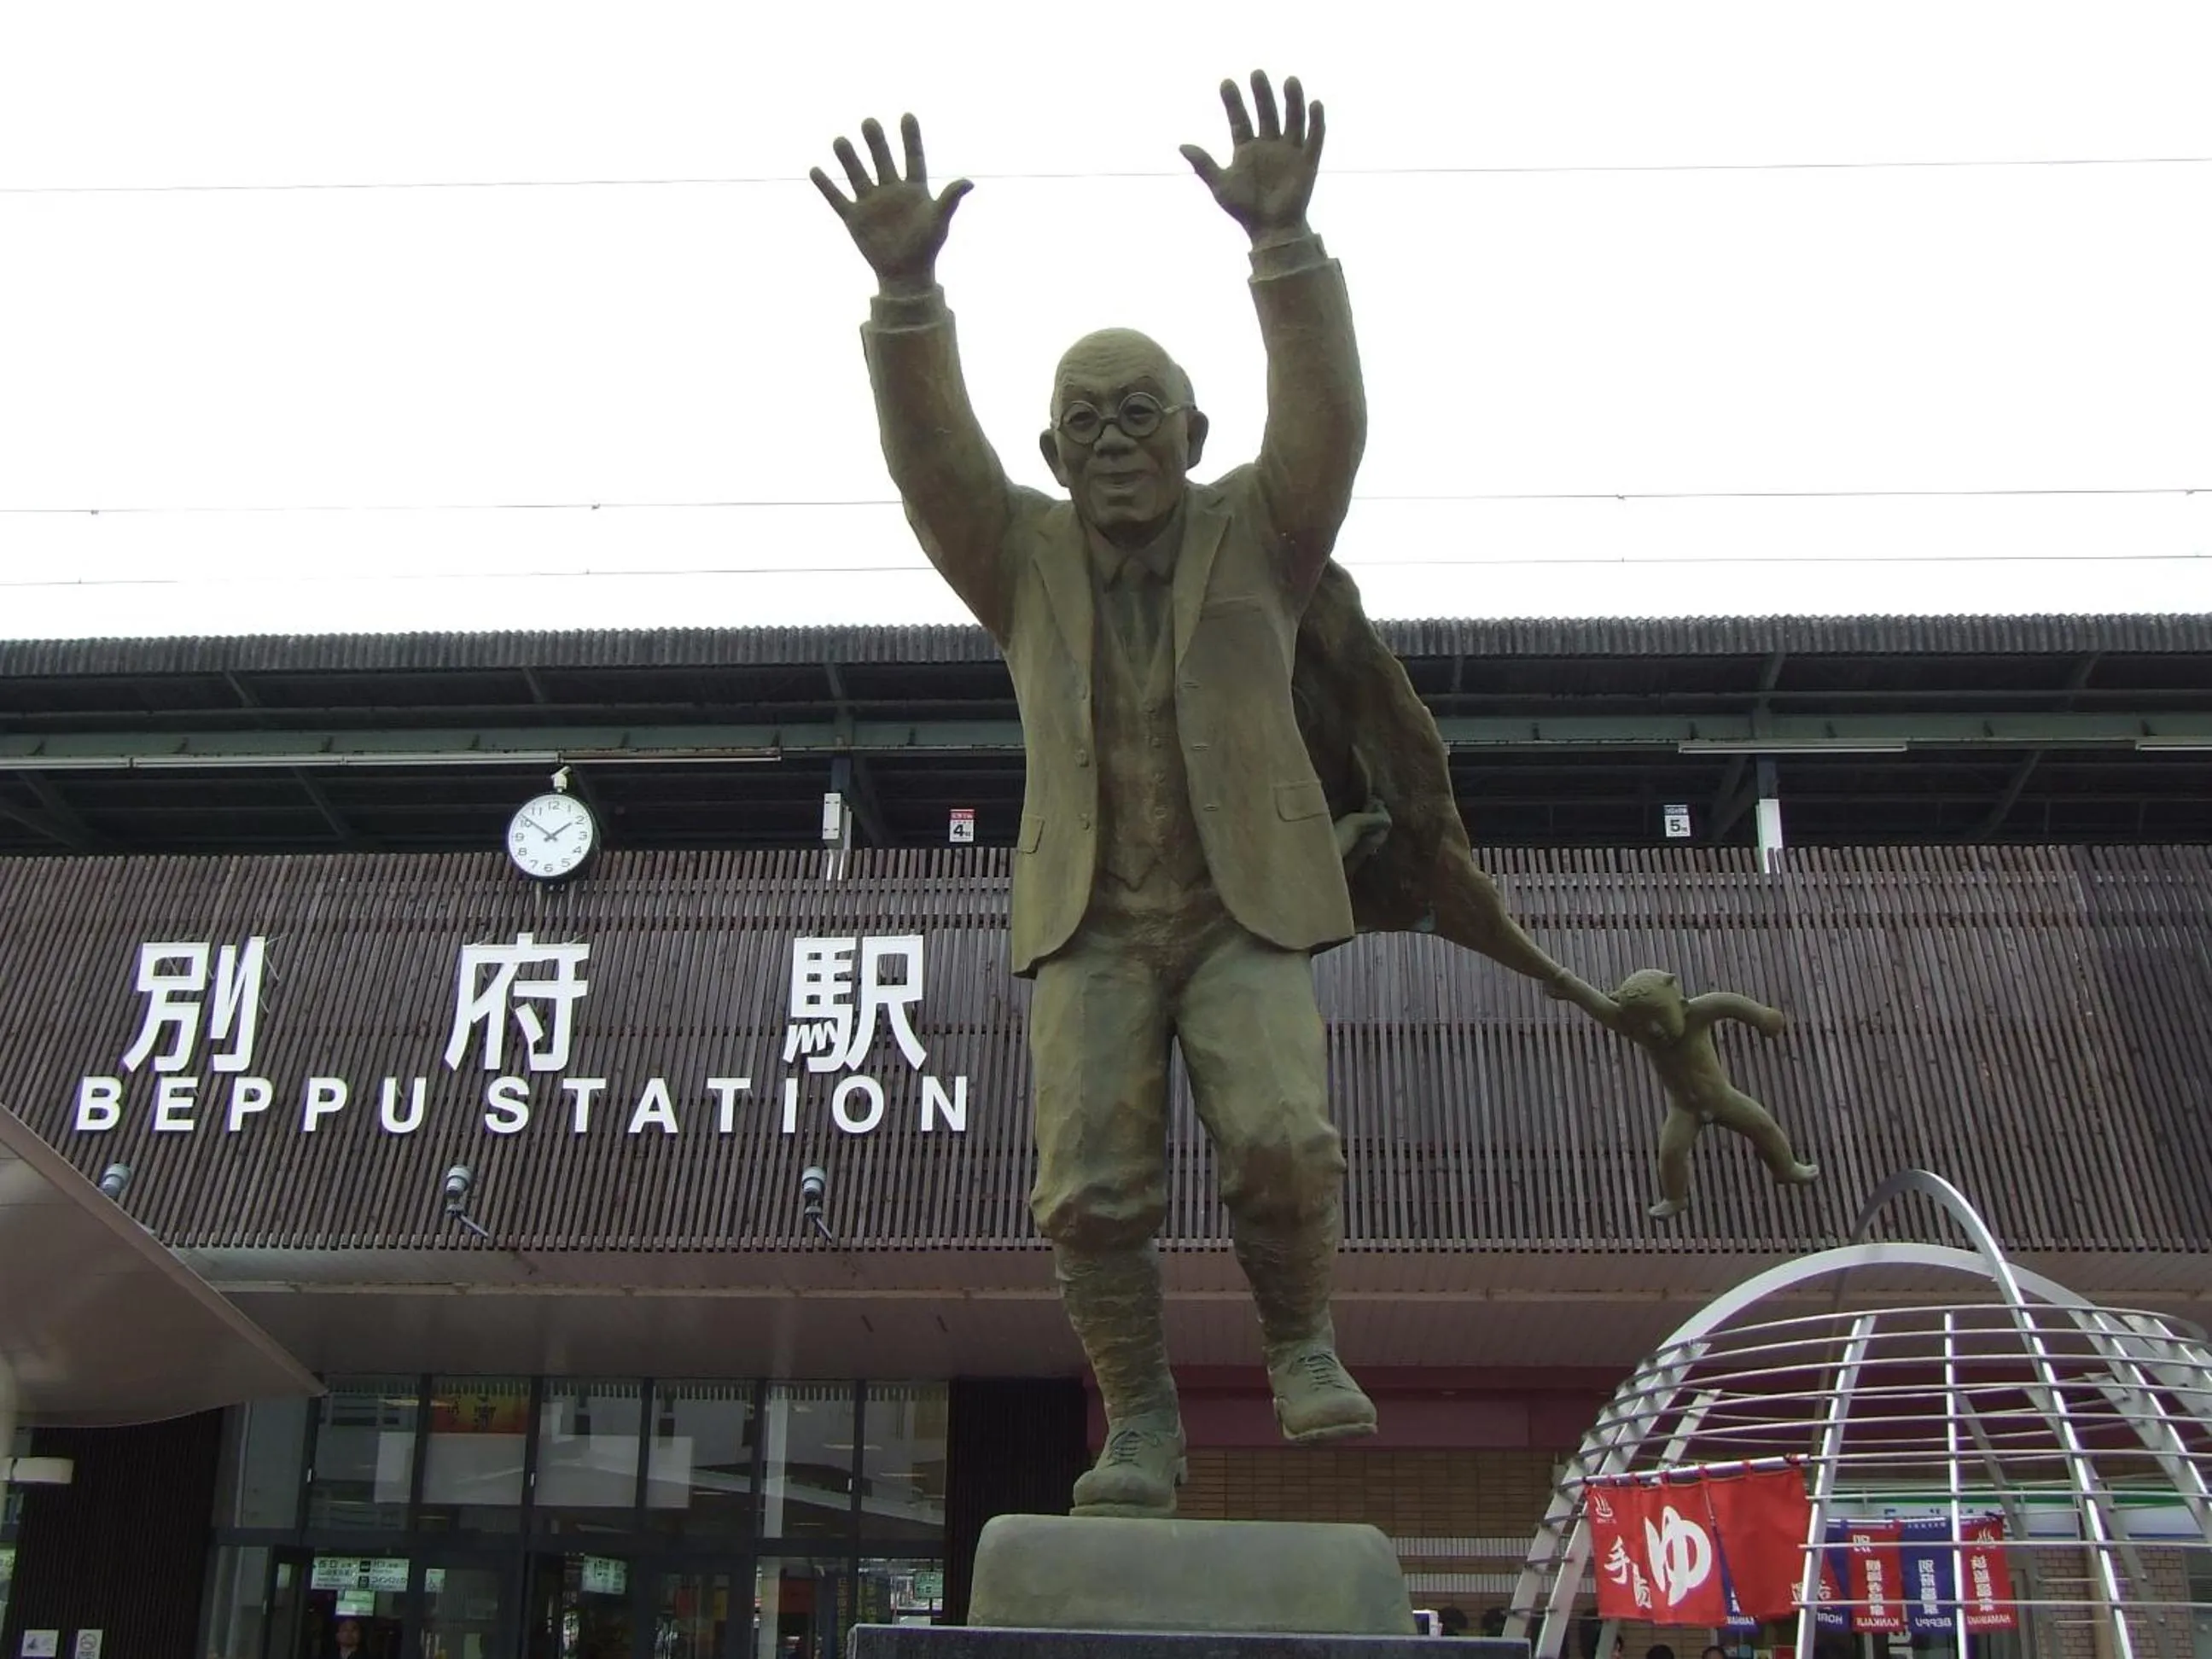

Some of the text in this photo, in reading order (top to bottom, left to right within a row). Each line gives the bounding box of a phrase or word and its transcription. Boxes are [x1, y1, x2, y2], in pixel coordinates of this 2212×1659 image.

[122, 933, 928, 1073] 別府駅
[76, 1074, 968, 1134] BEPPU STATION
[1644, 1505, 1712, 1606] ゆ
